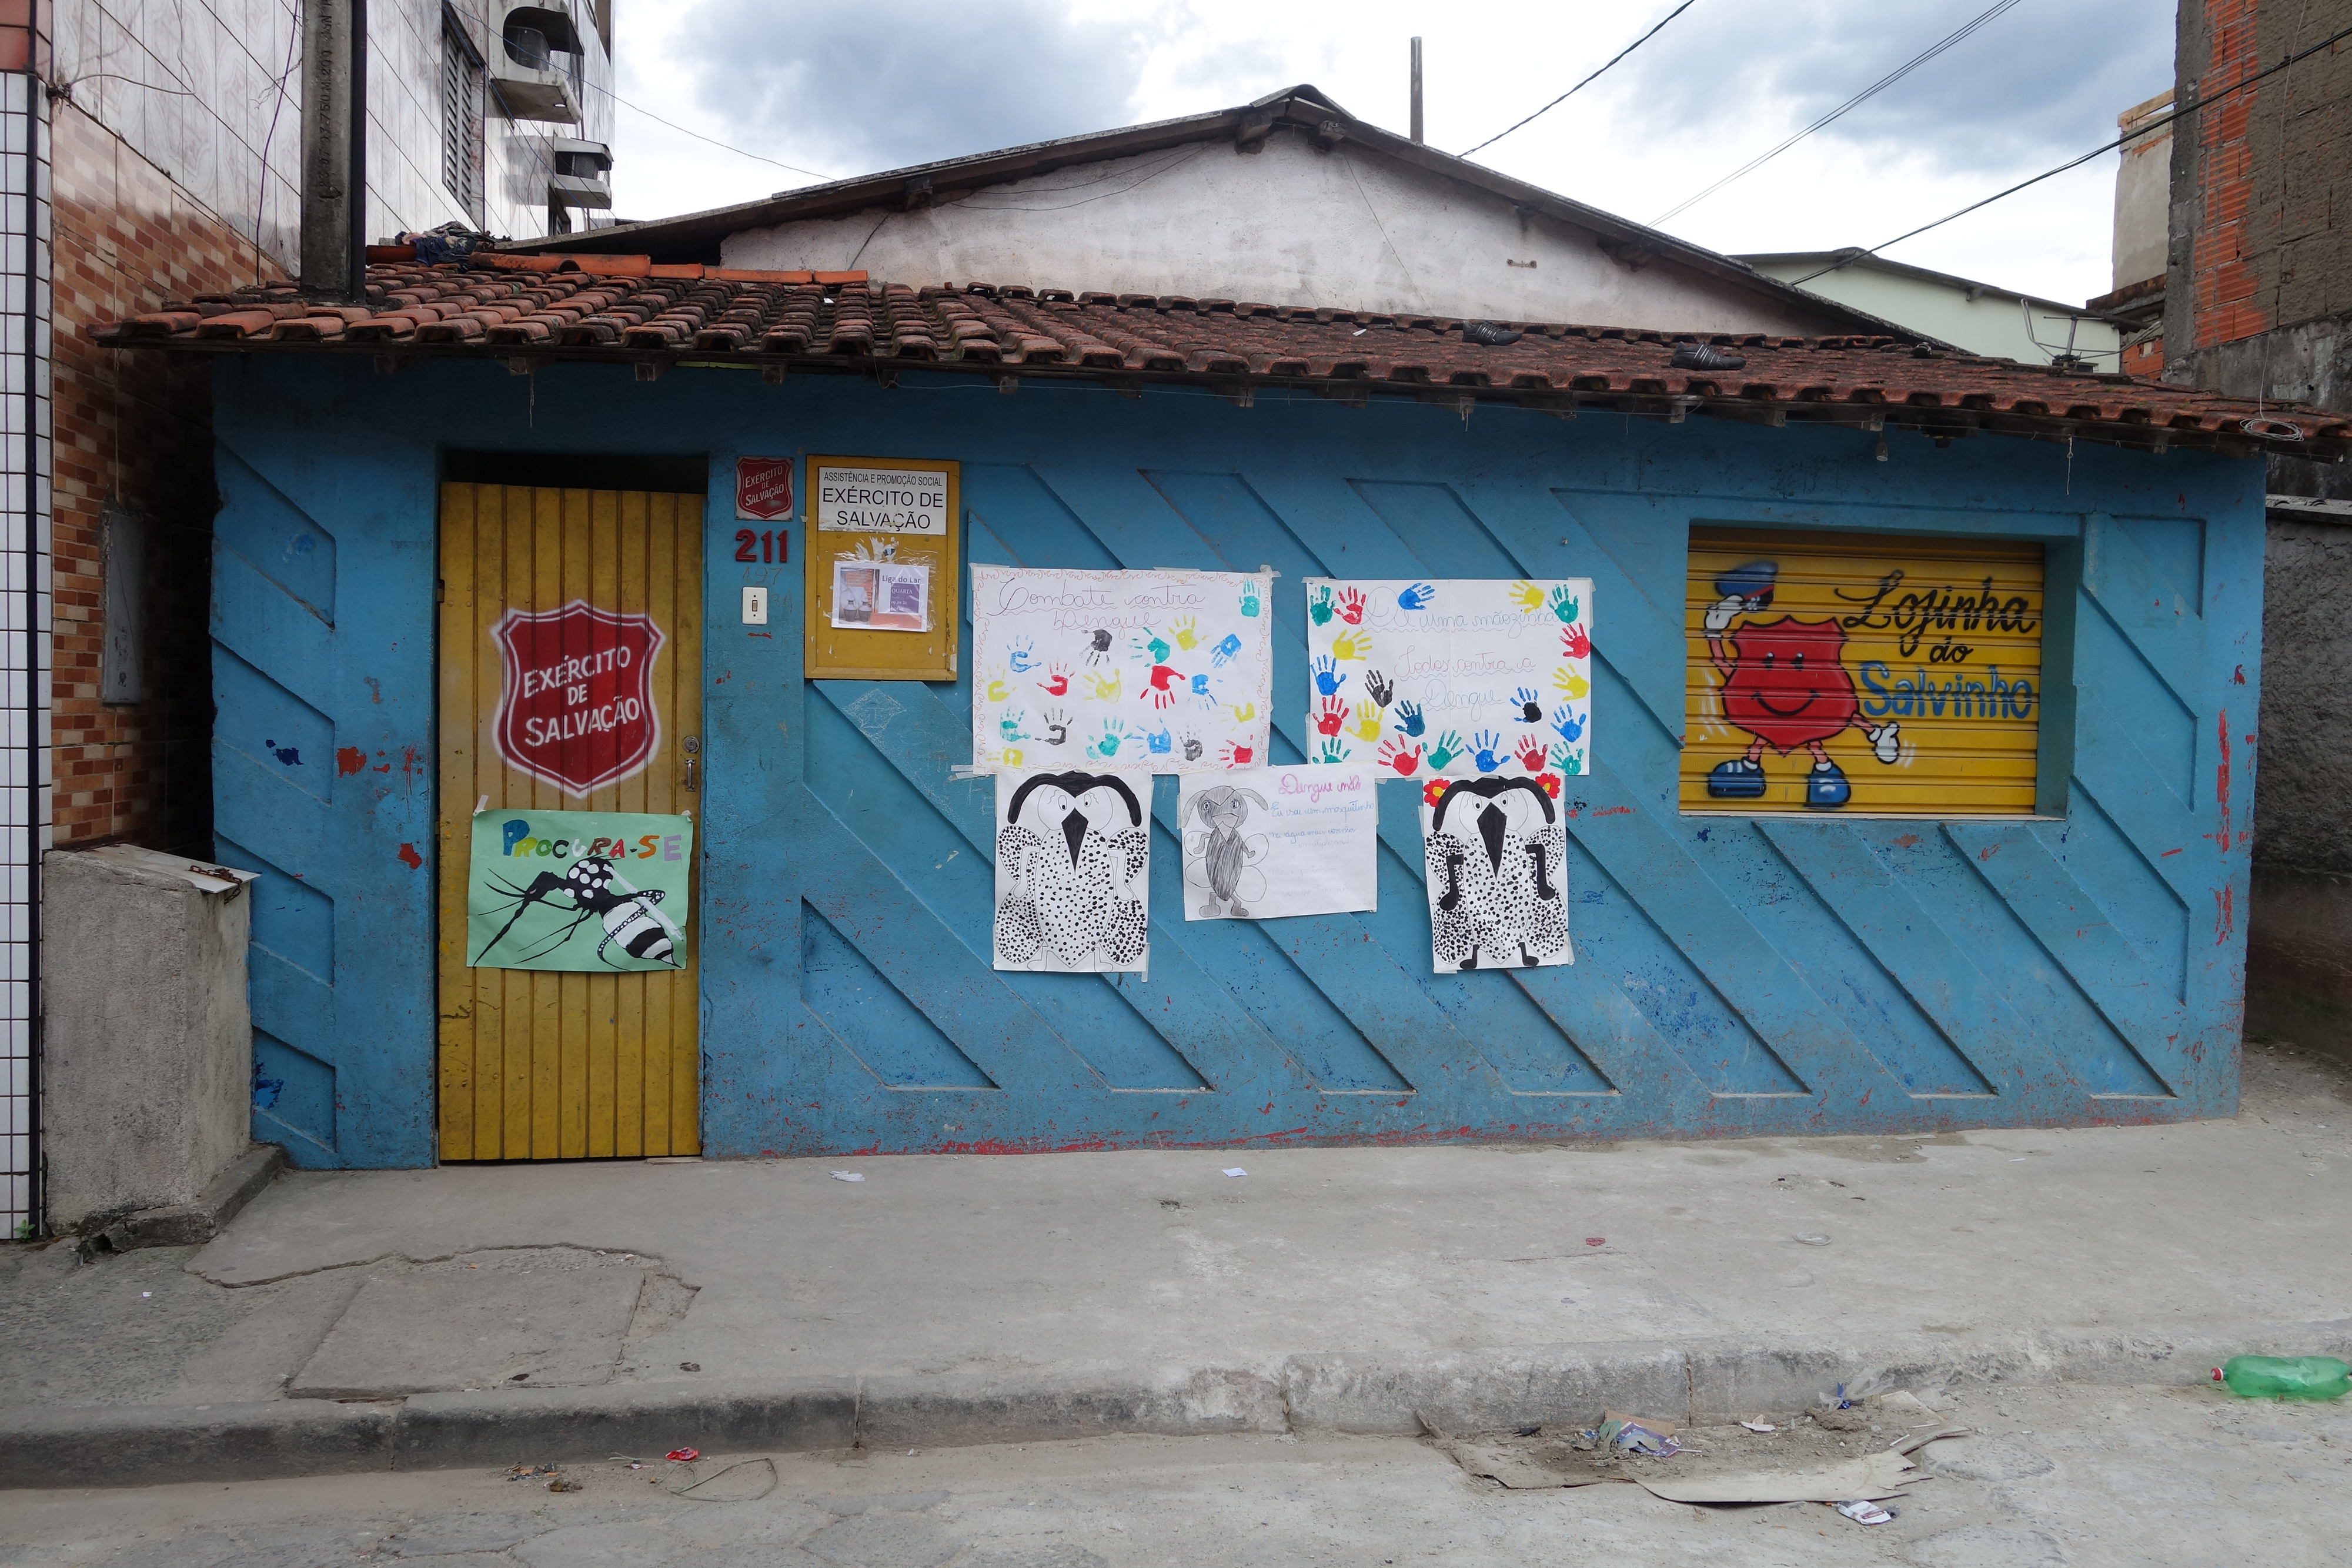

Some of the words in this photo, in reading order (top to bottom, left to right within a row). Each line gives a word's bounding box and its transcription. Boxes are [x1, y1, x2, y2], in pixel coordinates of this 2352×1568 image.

[745, 466, 783, 488] EXÉRCITO
[761, 480, 770, 489] DE
[824, 471, 869, 483] ASSISTÊNCIA
[870, 474, 875, 483] E
[877, 474, 916, 487] PROMOÇÃO
[918, 476, 943, 486] SOCIAL
[745, 483, 784, 506] SALVAÇÃO
[823, 486, 914, 506] EXÉRCITO
[920, 492, 943, 508] DE
[837, 510, 931, 531] SALVAÇÃO
[735, 528, 789, 563] 211
[882, 575, 896, 584] Liga
[987, 577, 1114, 615] Combate
[1125, 584, 1205, 608] contra
[1419, 613, 1468, 628] uma
[1834, 569, 2036, 657] Lojinha
[1394, 646, 1450, 675] Todos
[1452, 652, 1513, 673] contra
[1516, 657, 1536, 670] a
[1929, 636, 1974, 664] do
[523, 646, 631, 698] EXÉRCITO
[567, 684, 587, 706] DE
[1419, 679, 1502, 721] Dengue
[1859, 661, 2033, 720] Salvinho
[524, 696, 640, 747] SALVAÇÃO
[1278, 774, 1333, 803] Dengue
[1271, 801, 1283, 817] Eu
[502, 818, 683, 862] PROCURA-SE
[1284, 830, 1306, 844] água
